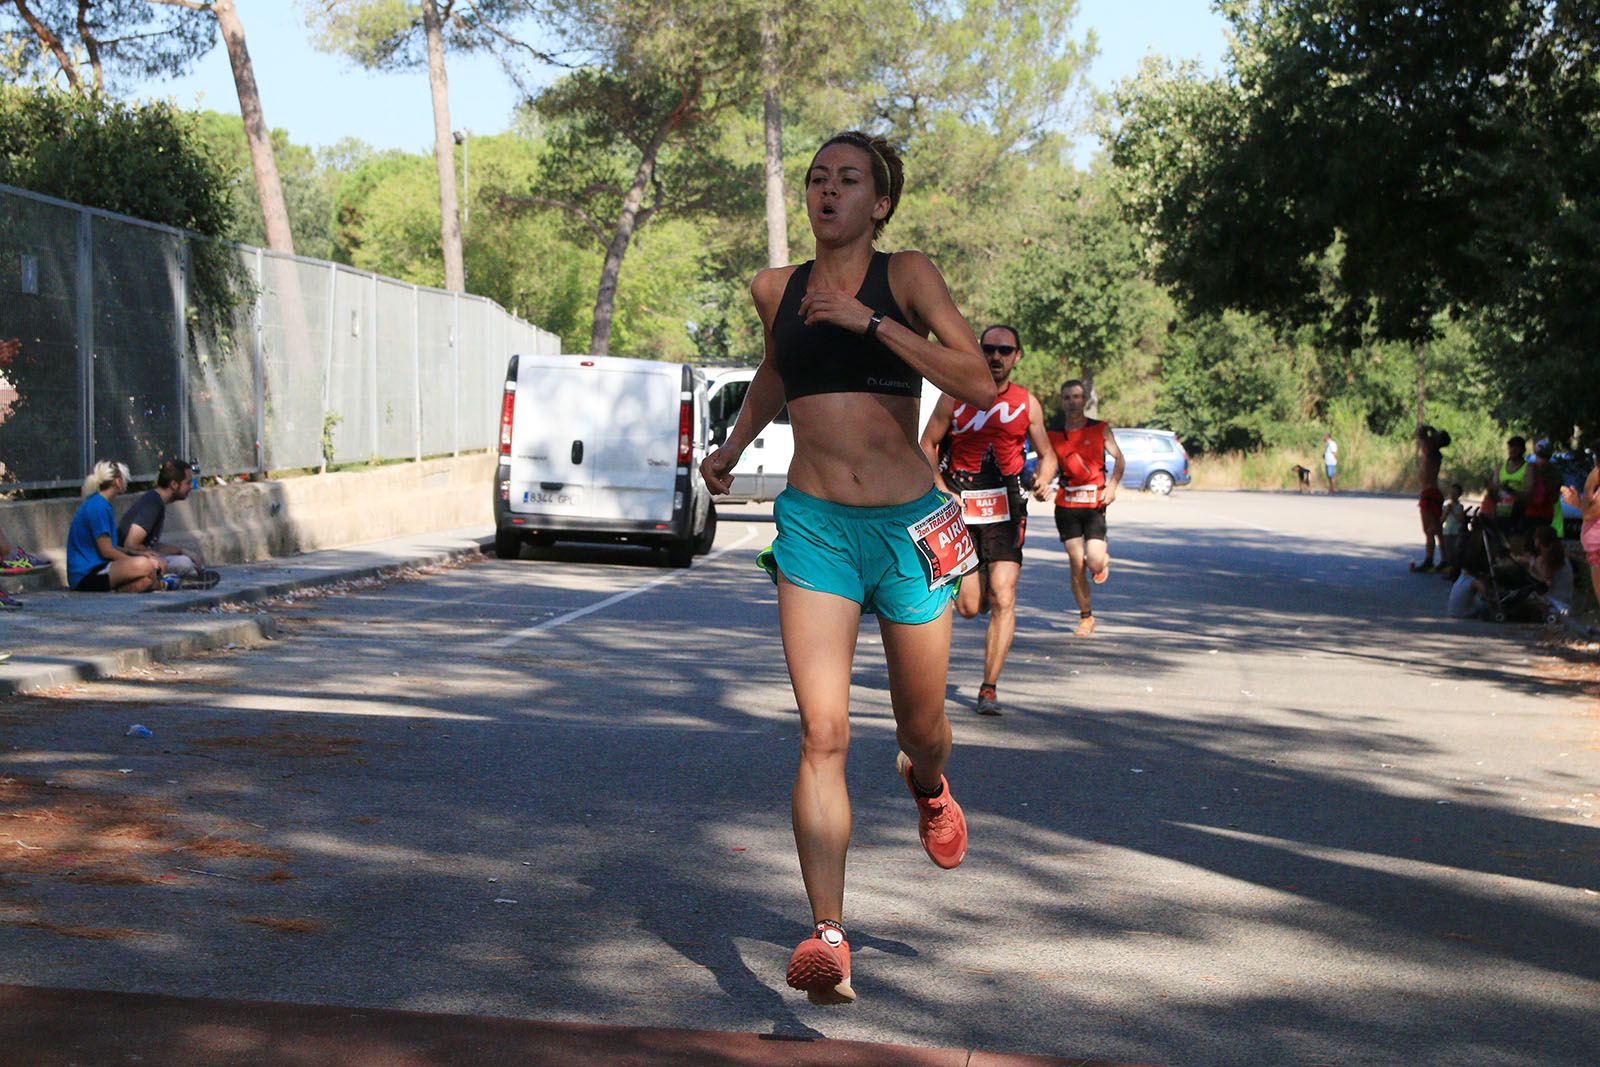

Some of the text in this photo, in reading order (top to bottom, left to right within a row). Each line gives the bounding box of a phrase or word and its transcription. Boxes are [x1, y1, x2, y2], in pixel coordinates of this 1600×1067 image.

[530, 492, 553, 503] 8344
[976, 497, 998, 507] RALF
[981, 507, 994, 517] 35
[929, 515, 947, 530] TRAIL
[954, 531, 973, 562] 22
